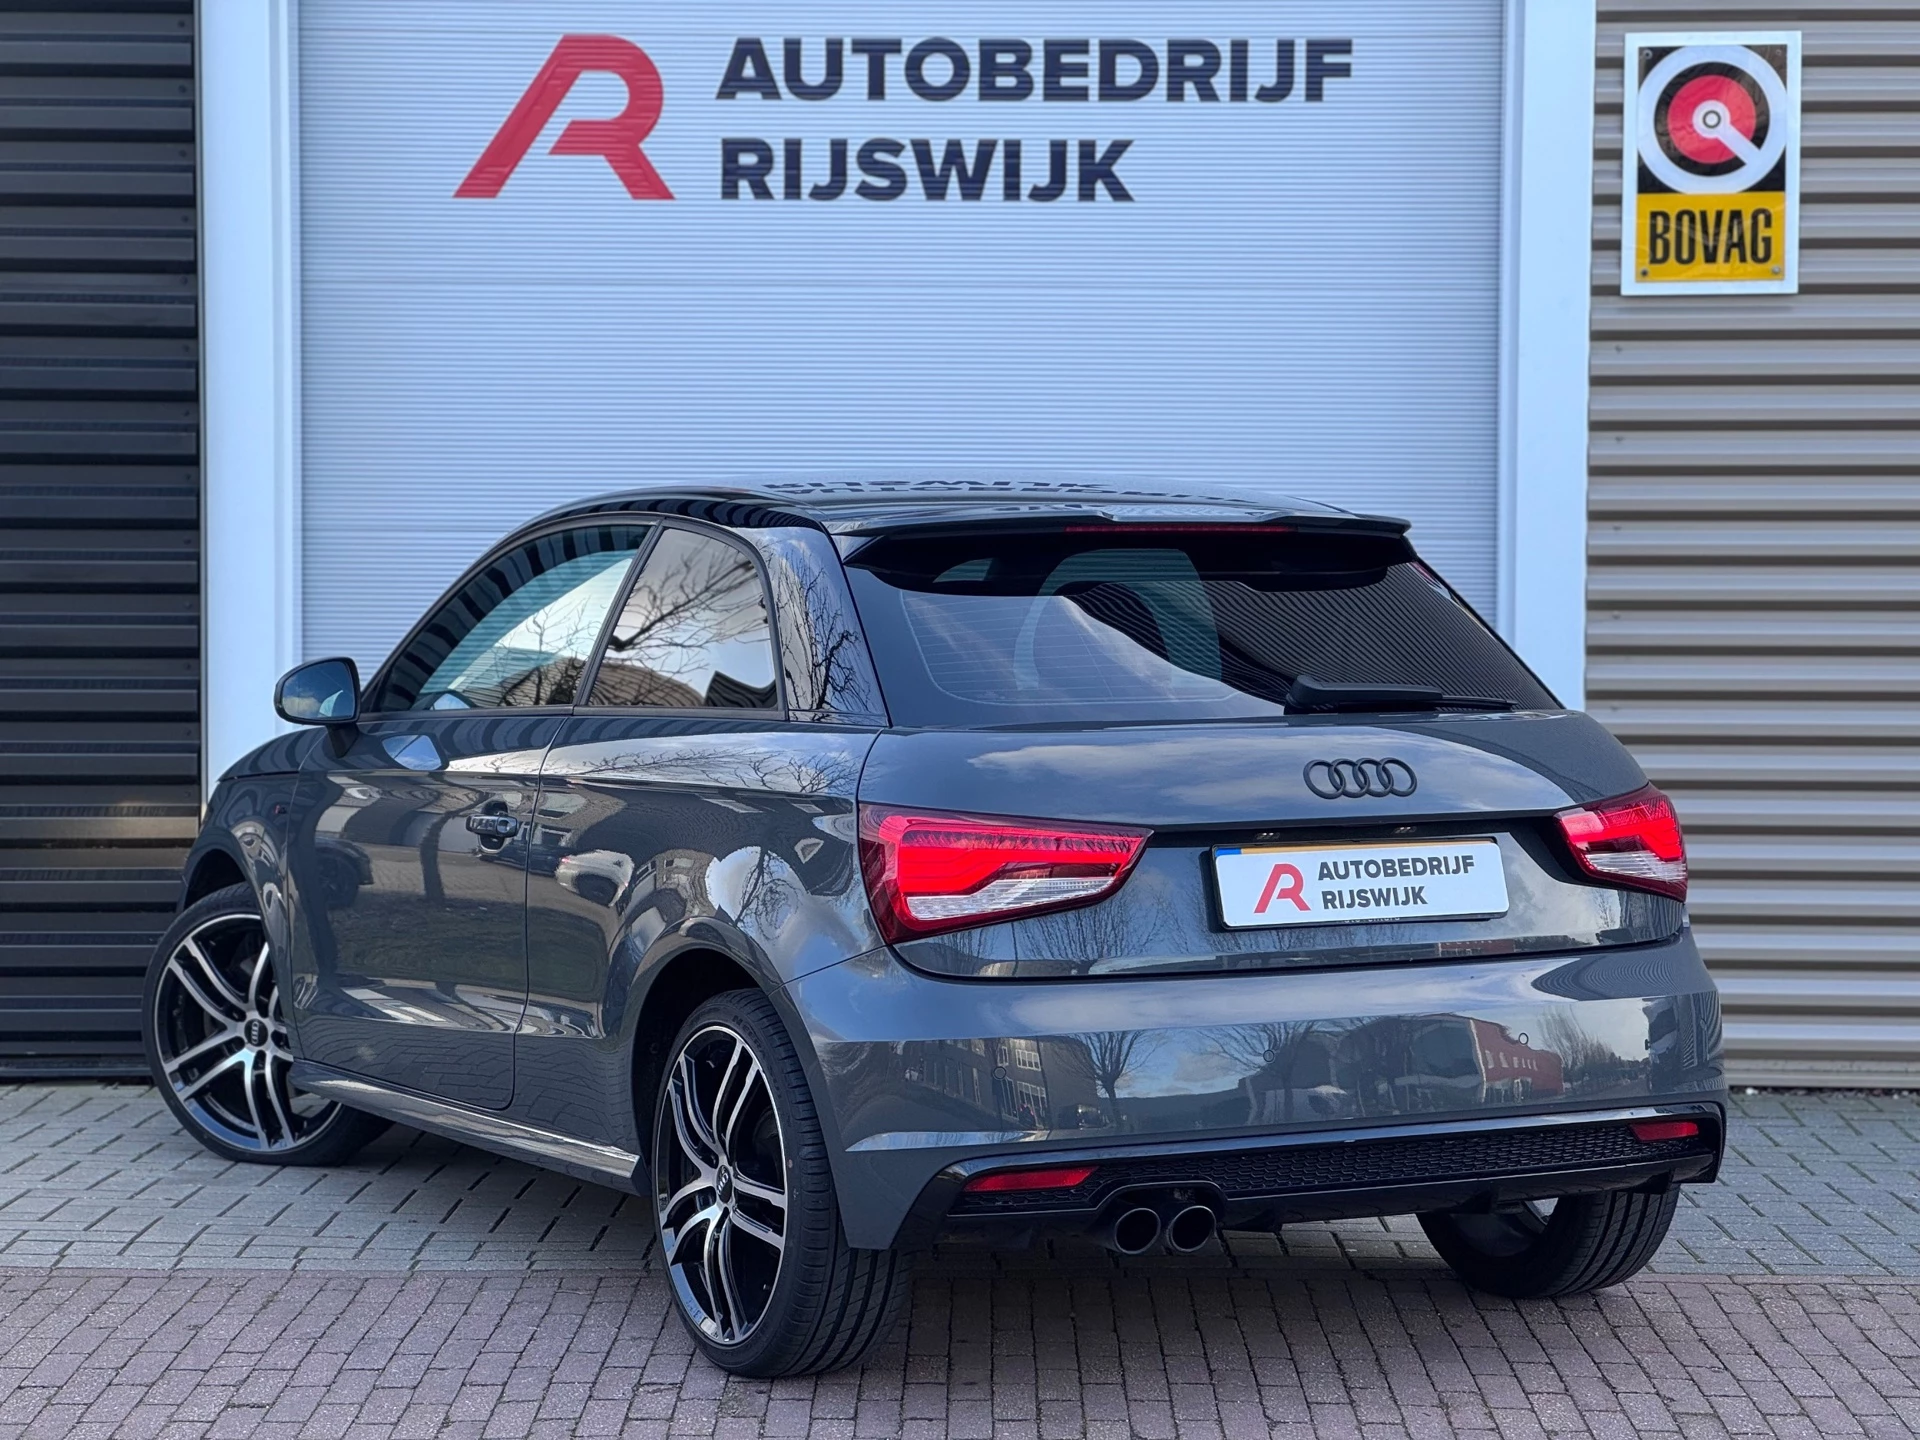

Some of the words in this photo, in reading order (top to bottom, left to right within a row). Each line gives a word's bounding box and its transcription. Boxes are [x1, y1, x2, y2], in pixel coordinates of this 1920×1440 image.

[716, 36, 1353, 103] AUTOBEDRIJF
[721, 138, 1135, 203] RIJSWIJK
[1649, 208, 1772, 265] BOVAG
[1318, 855, 1475, 881] AUTOBEDRIJF
[1321, 886, 1428, 910] RIJSWIJK
